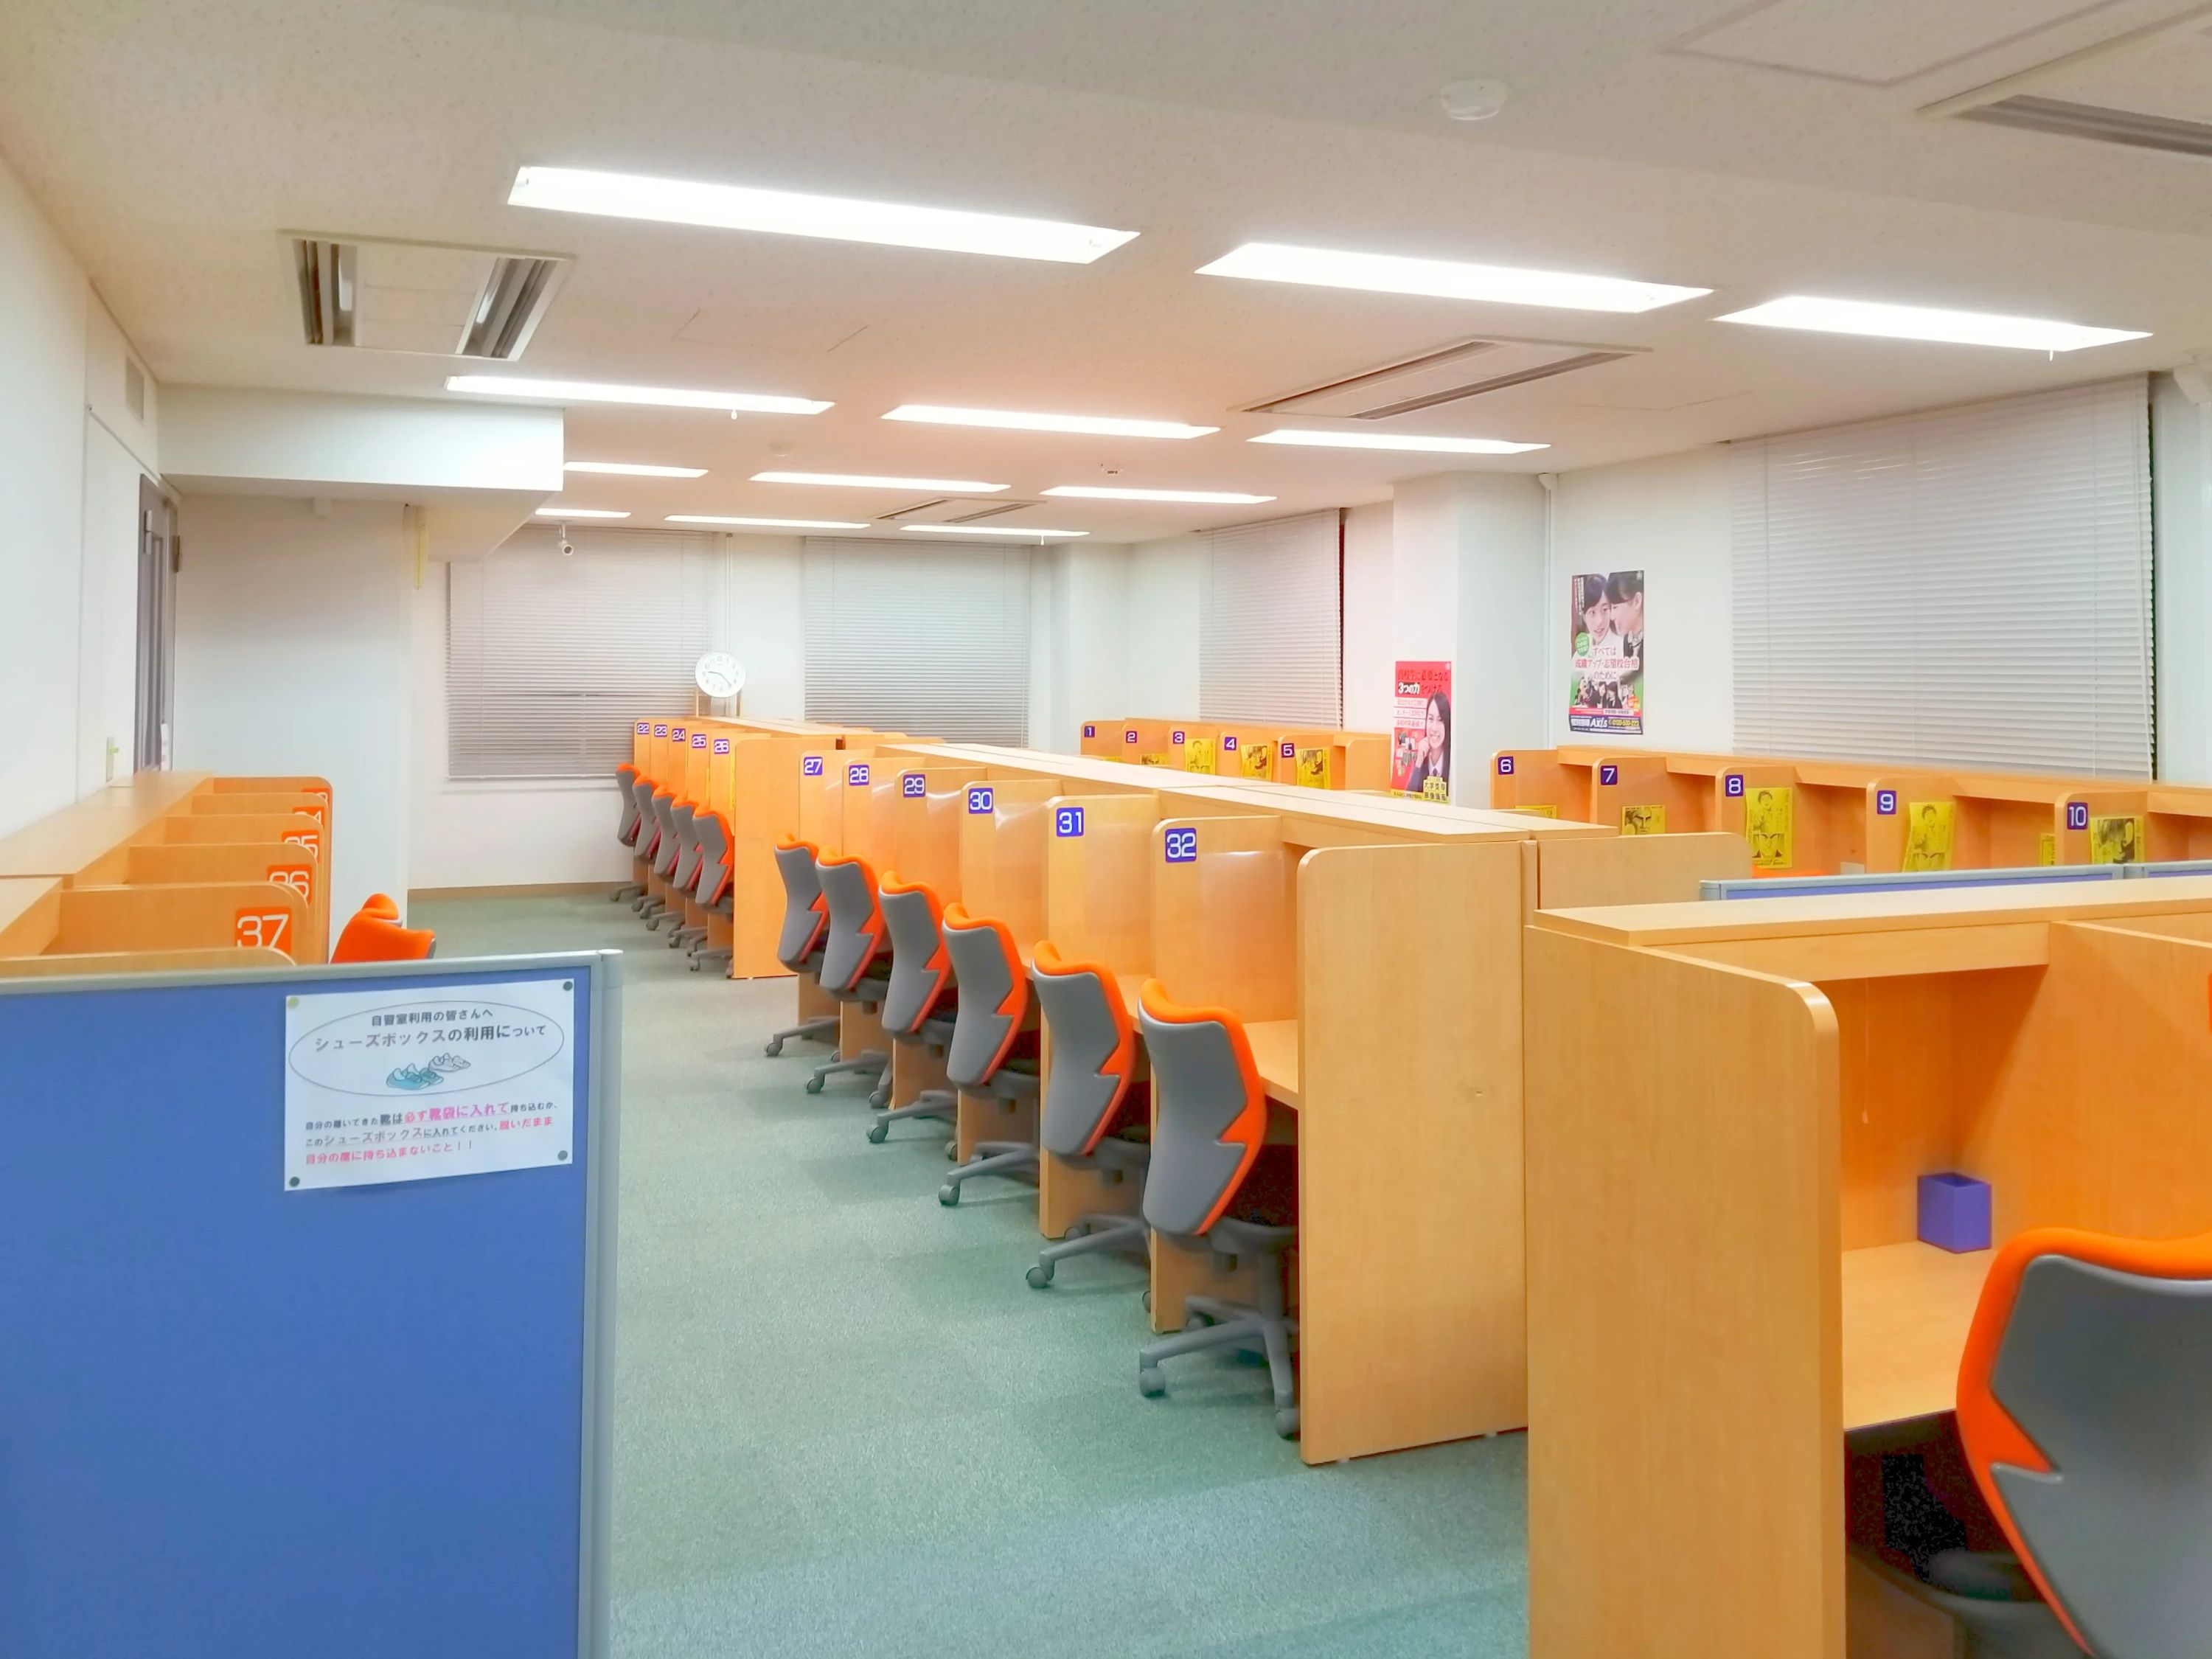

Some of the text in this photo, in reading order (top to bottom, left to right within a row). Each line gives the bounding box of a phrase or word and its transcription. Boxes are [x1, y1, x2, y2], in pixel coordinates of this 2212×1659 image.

[637, 723, 650, 734] 22
[655, 726, 667, 736] 23
[672, 729, 686, 741] 24
[692, 736, 706, 747] 25
[1127, 732, 1136, 742] 2
[1174, 733, 1183, 743] 3
[1225, 738, 1236, 749] 4
[714, 740, 729, 753] 26
[1283, 745, 1293, 756] 5
[804, 758, 822, 773] 27
[1500, 759, 1512, 773] 6
[849, 768, 869, 784] 28
[1603, 768, 1615, 783] 7
[904, 777, 925, 795] 29
[1728, 778, 1742, 795] 8
[969, 791, 992, 810] 30
[1880, 793, 1894, 812] 9
[1059, 812, 1082, 833] 31
[2069, 806, 2087, 827] 10
[1166, 832, 1195, 858] 32
[237, 914, 289, 949] 37
[372, 1008, 493, 1026] 自習室利用の皆さんへ
[316, 1025, 546, 1051] シューズボックスの利用について
